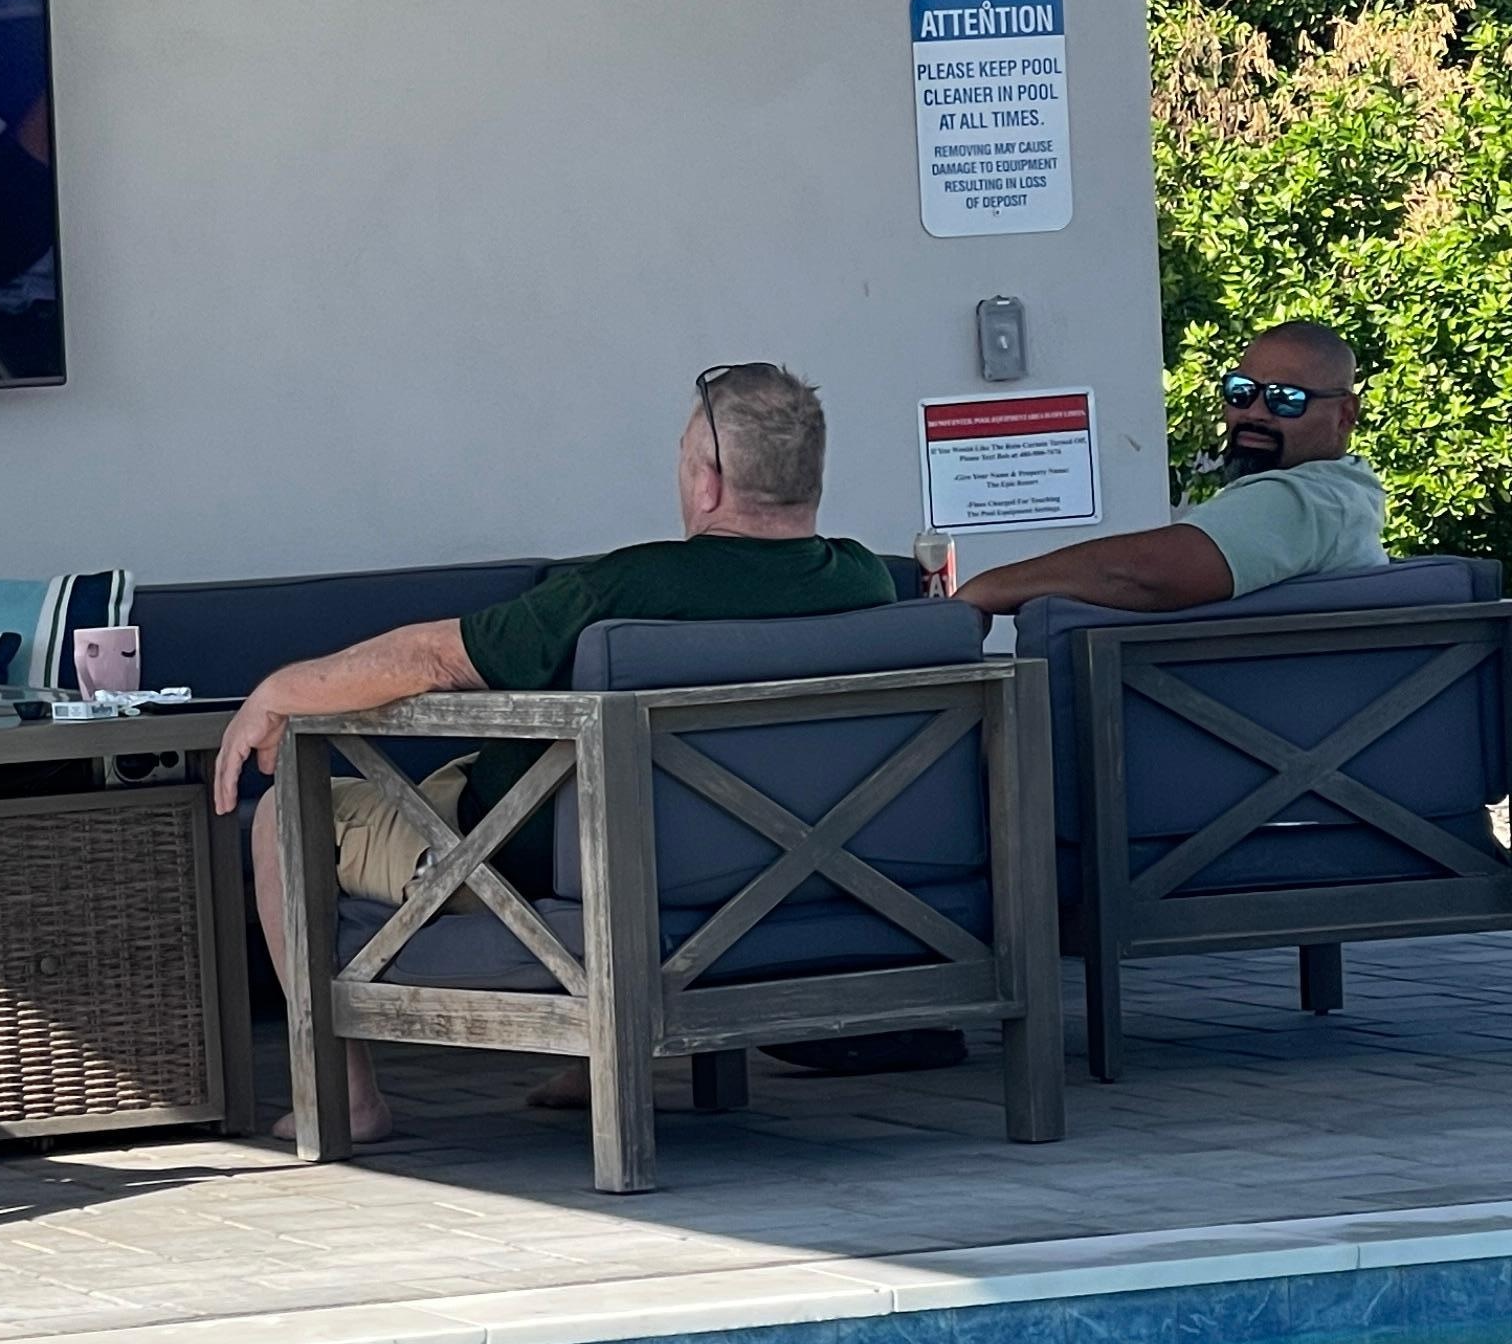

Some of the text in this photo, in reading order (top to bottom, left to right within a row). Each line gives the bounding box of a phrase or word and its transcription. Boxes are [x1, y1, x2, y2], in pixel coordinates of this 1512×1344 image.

[921, 5, 1053, 38] ATTENTION
[917, 58, 1062, 80] PLEASE KEEP POOL
[924, 83, 1058, 106] CLEANER IN POOL
[939, 110, 1045, 131] AT ALL TIMES.
[935, 140, 1053, 158] REMOVING MAY CAUSE
[932, 158, 1058, 176] DAMAGE TO EQUIPMENT
[945, 176, 1046, 192] RESULTING IN LOSS
[966, 194, 1028, 209] OF DEPOSIT
